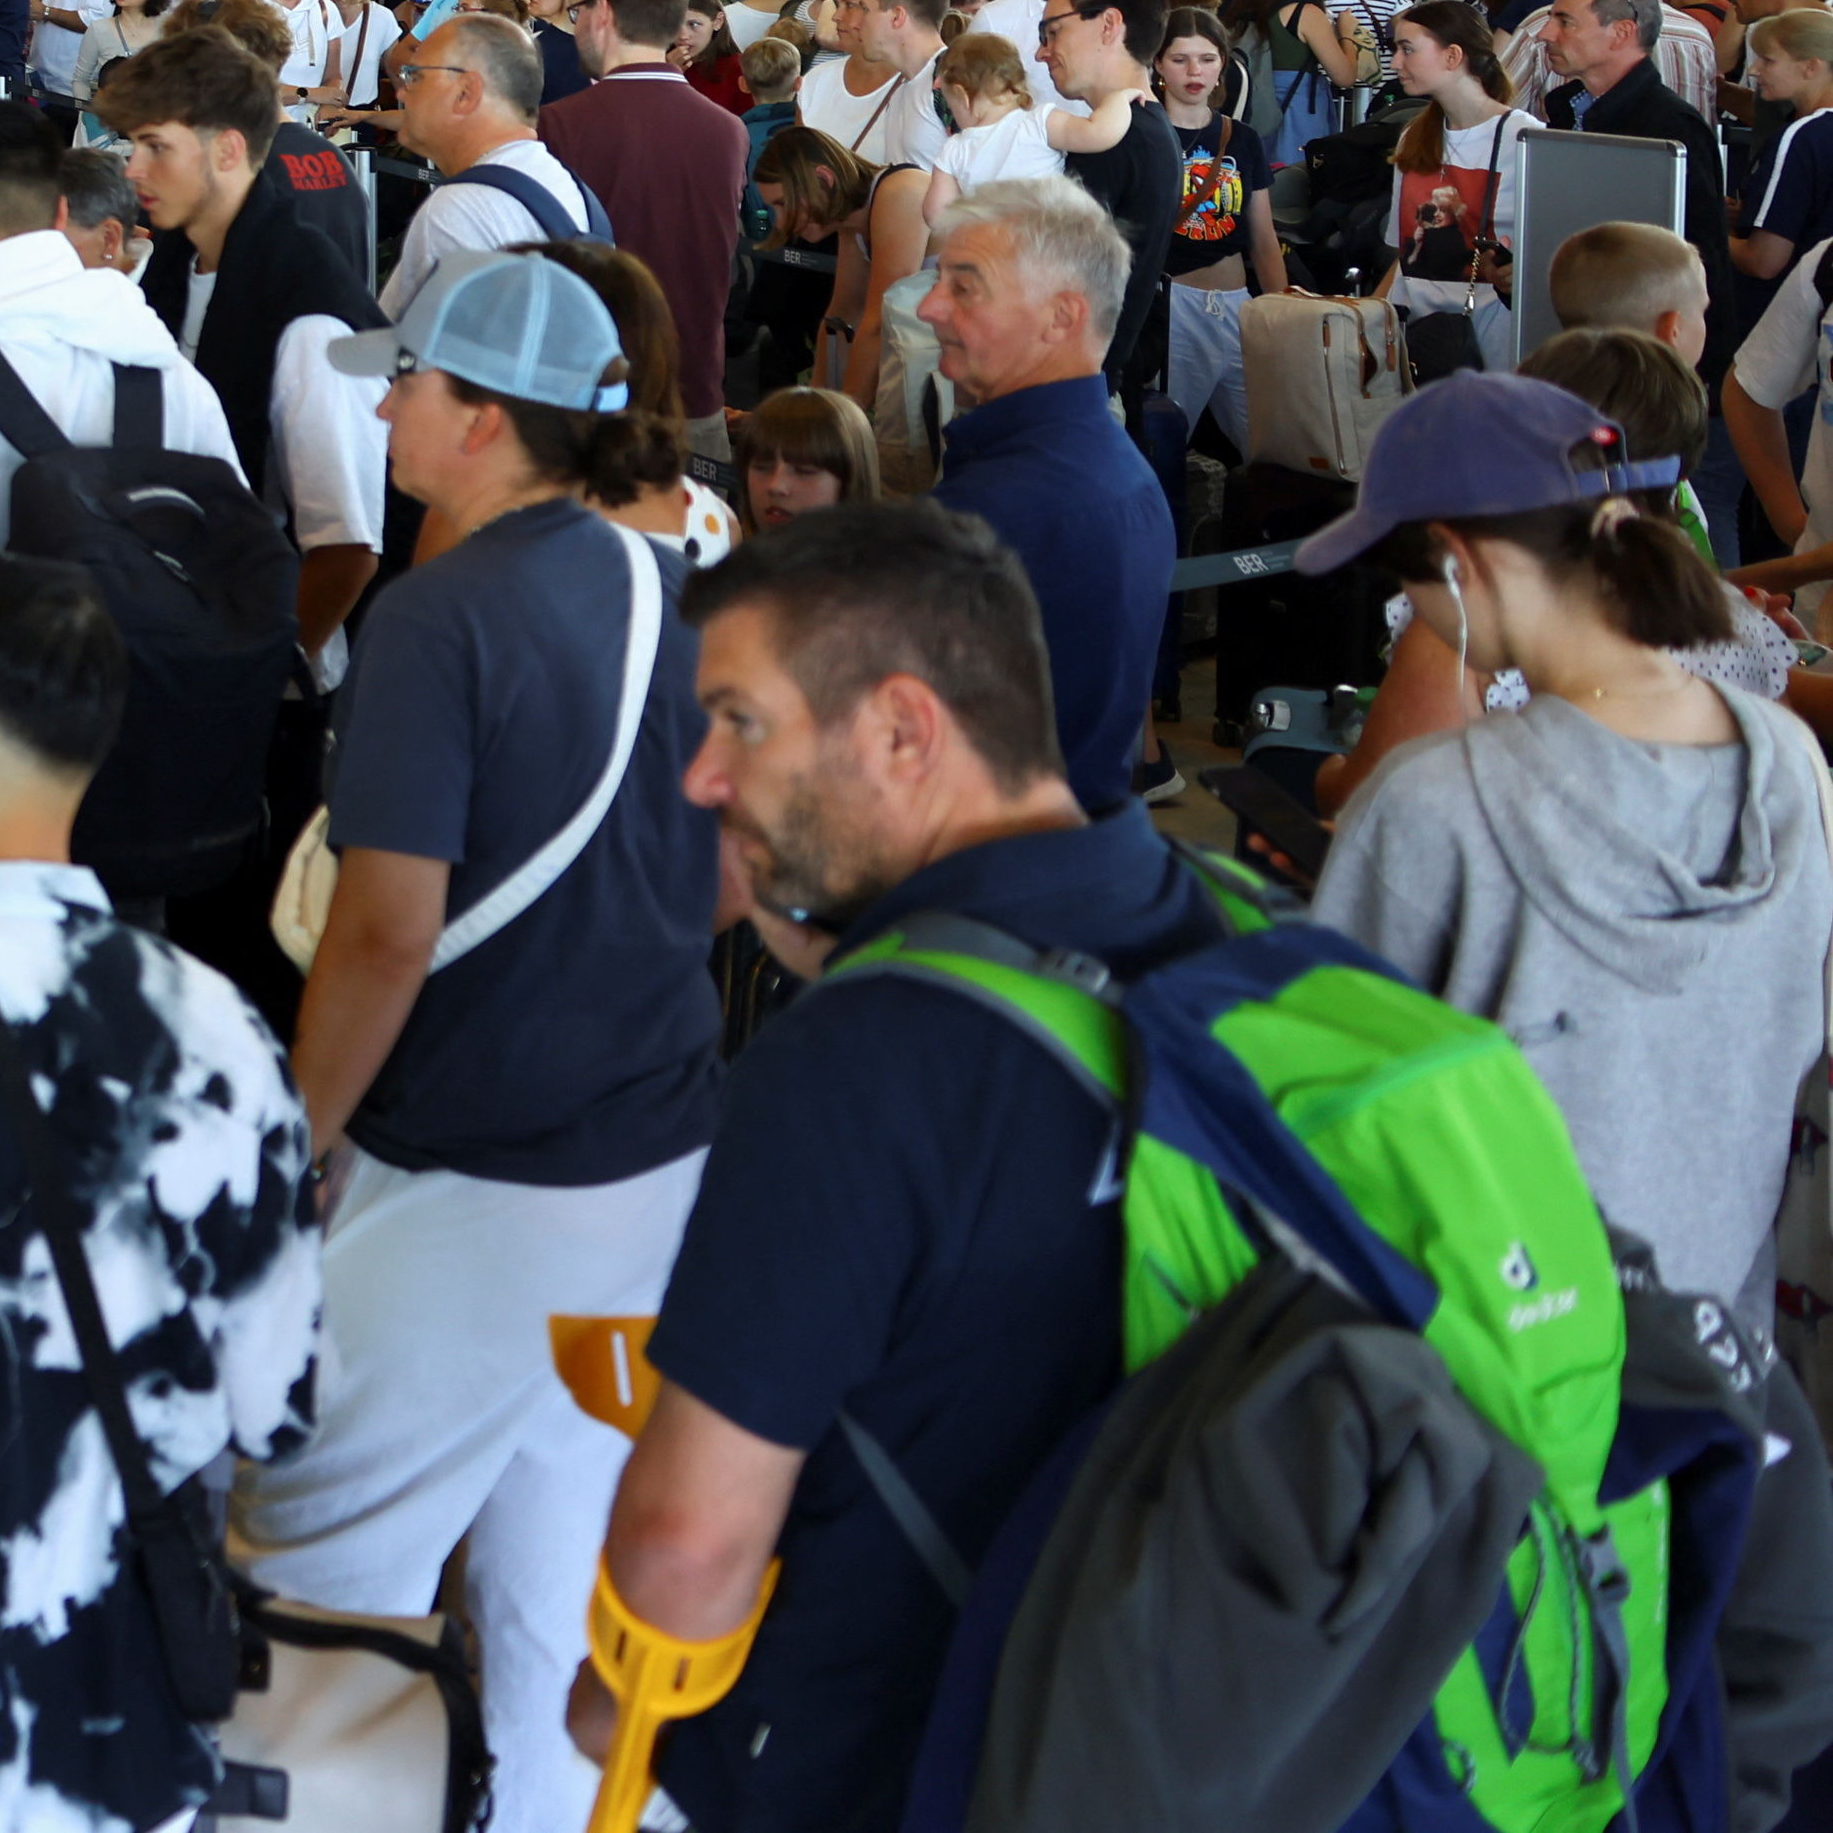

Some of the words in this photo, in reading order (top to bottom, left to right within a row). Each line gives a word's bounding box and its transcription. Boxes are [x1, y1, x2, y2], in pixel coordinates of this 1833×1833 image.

[278, 150, 345, 179] BOB
[290, 173, 348, 191] MARLEY
[784, 249, 801, 265] BER
[692, 457, 718, 483] BER
[1232, 553, 1270, 575] BER
